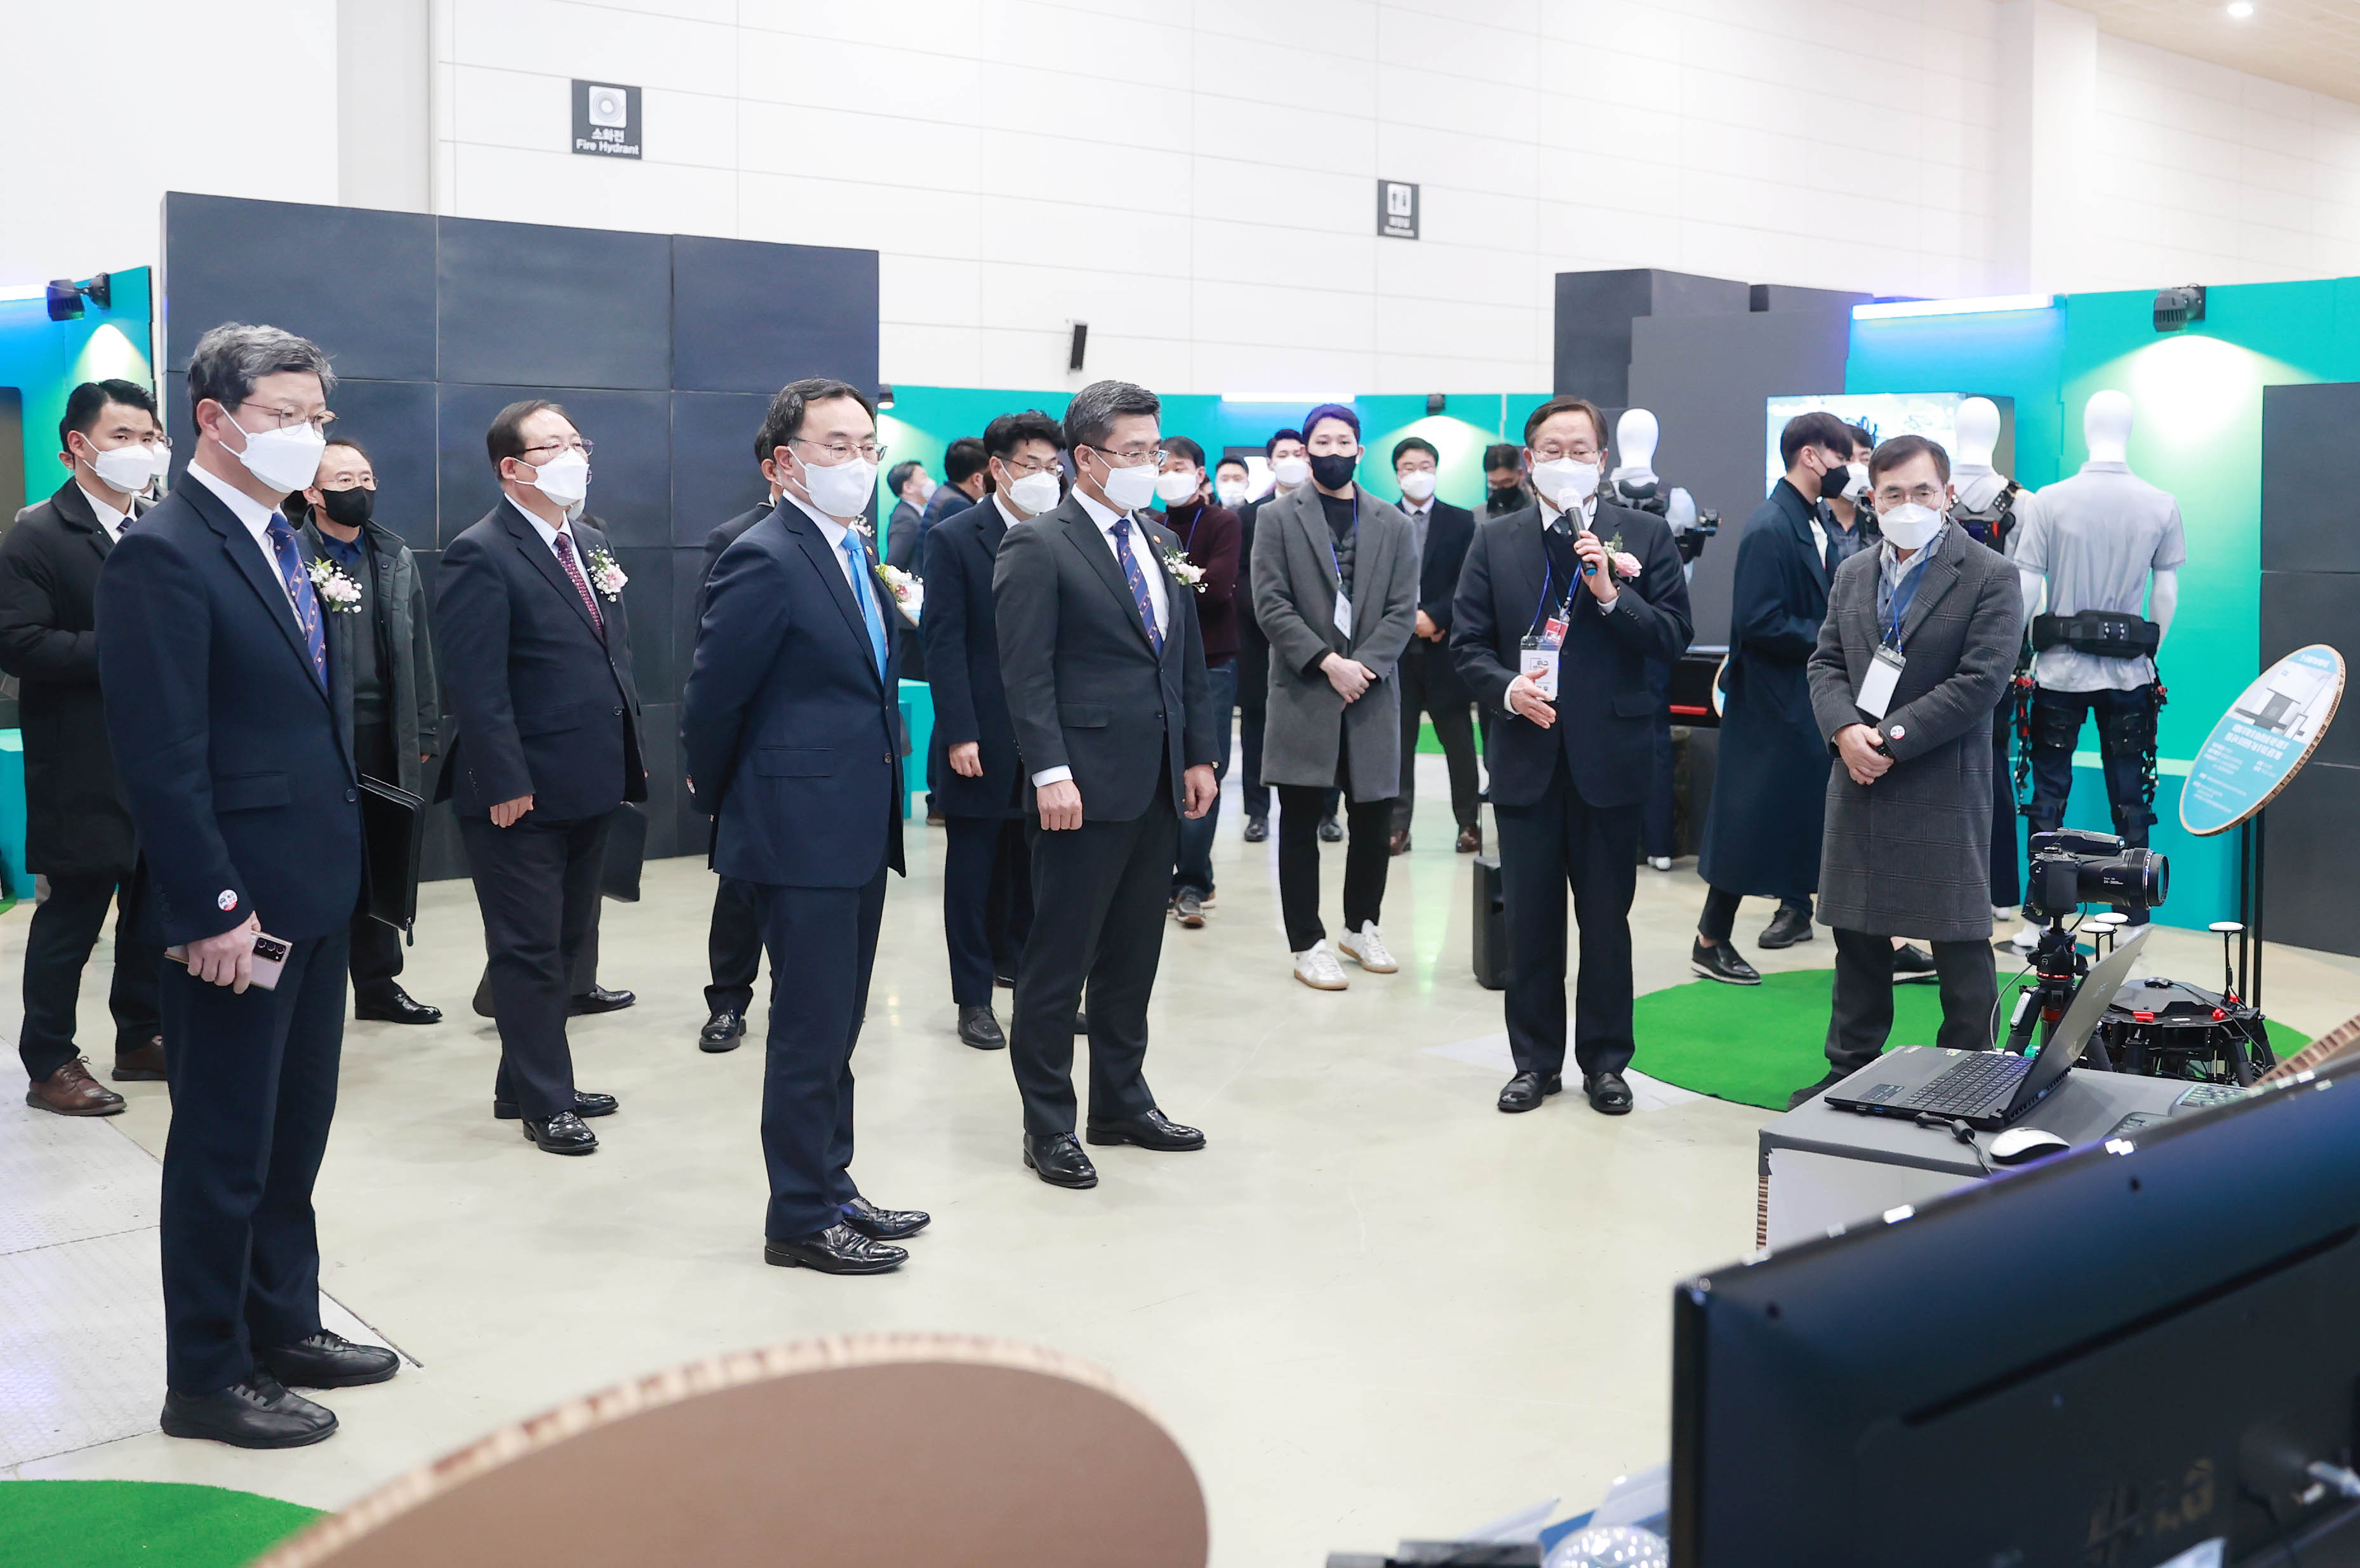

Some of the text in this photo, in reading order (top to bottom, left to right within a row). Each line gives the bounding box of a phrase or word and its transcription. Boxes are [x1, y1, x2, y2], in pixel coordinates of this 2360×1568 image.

[591, 128, 625, 143] 소화전
[576, 138, 639, 154] Fire Hydrant
